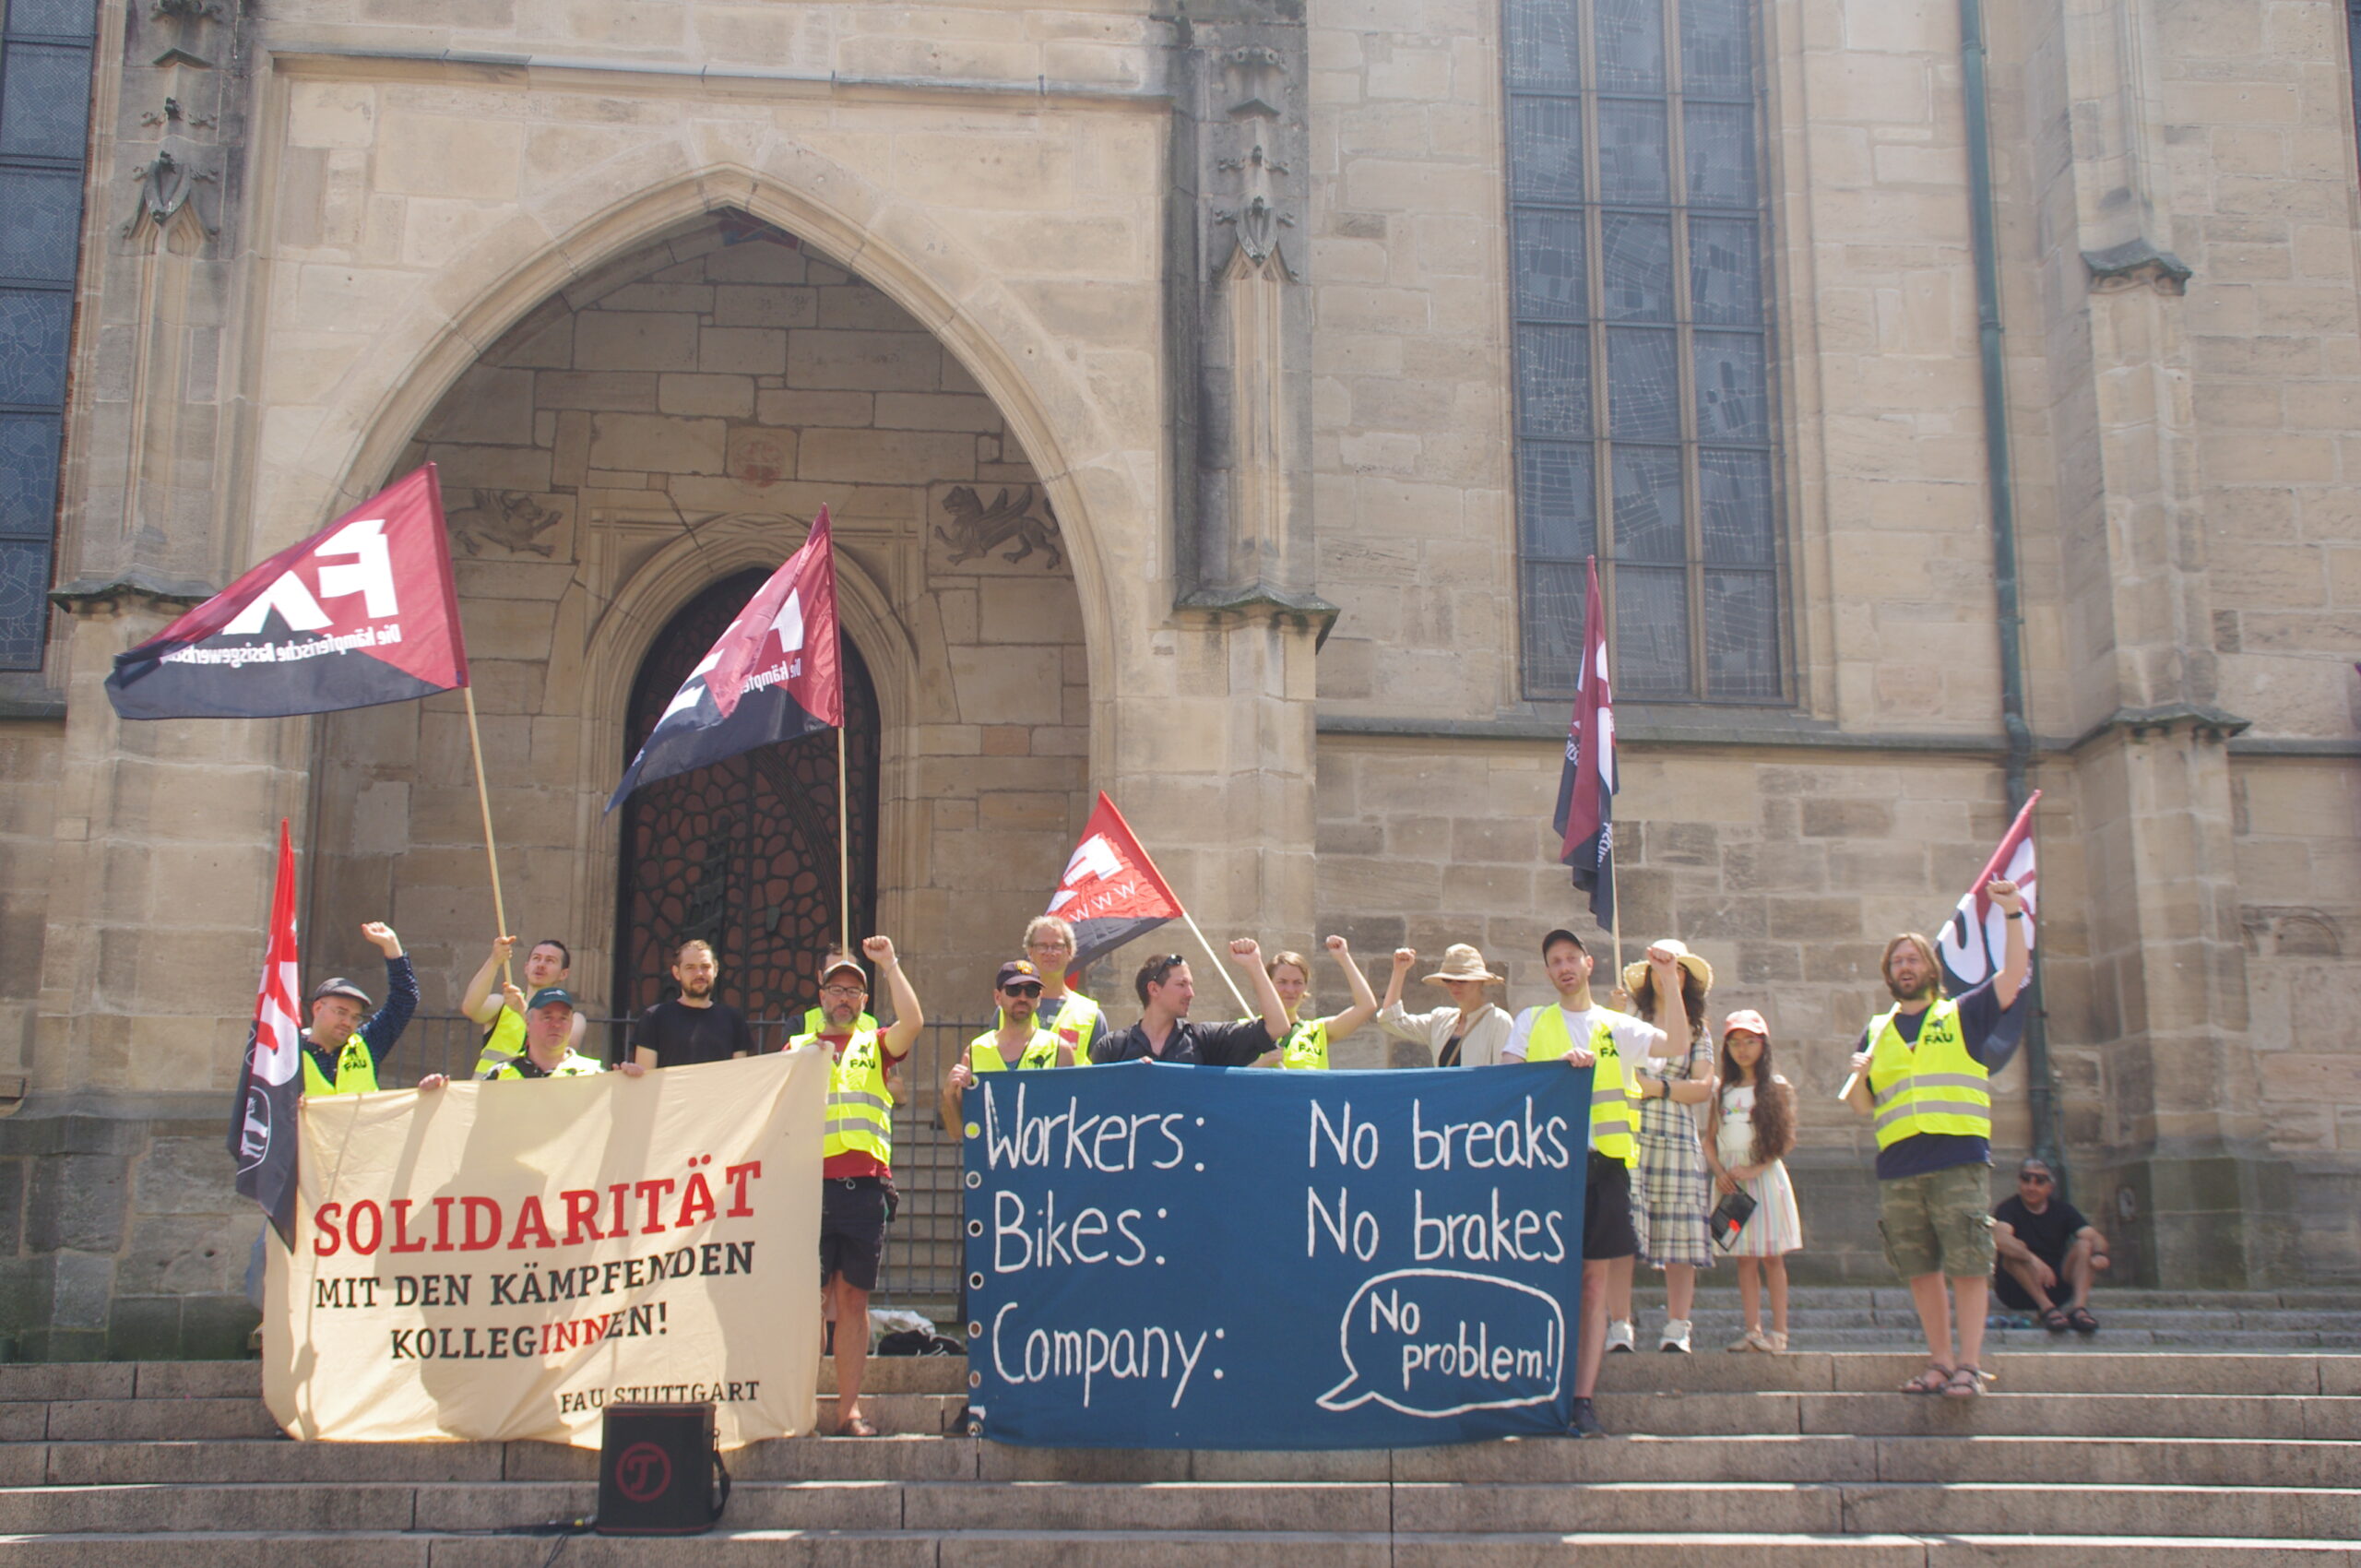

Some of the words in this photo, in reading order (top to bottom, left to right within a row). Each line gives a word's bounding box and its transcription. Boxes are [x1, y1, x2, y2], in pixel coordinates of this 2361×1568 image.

[344, 1059, 367, 1071] FAU
[849, 1059, 875, 1069] FAU
[1600, 1047, 1619, 1057] FA
[1924, 1033, 1953, 1045] FAU
[983, 1082, 1205, 1172] Workers:
[1308, 1098, 1379, 1170] No
[1412, 1094, 1570, 1171] breaks
[313, 1154, 762, 1256] SOLIDARITÄT
[994, 1189, 1168, 1274] Bikes:
[1307, 1185, 1380, 1262] No
[1414, 1186, 1565, 1265] brakes
[316, 1277, 381, 1309] MIT
[395, 1274, 472, 1307] DEN
[490, 1241, 755, 1306] KÄMPFENDEN
[391, 1301, 668, 1360] KOLLEGINNEN!
[992, 1301, 1225, 1409] Company:
[1370, 1288, 1420, 1336] No
[1402, 1319, 1554, 1391] problem!
[561, 1385, 606, 1414] FAU
